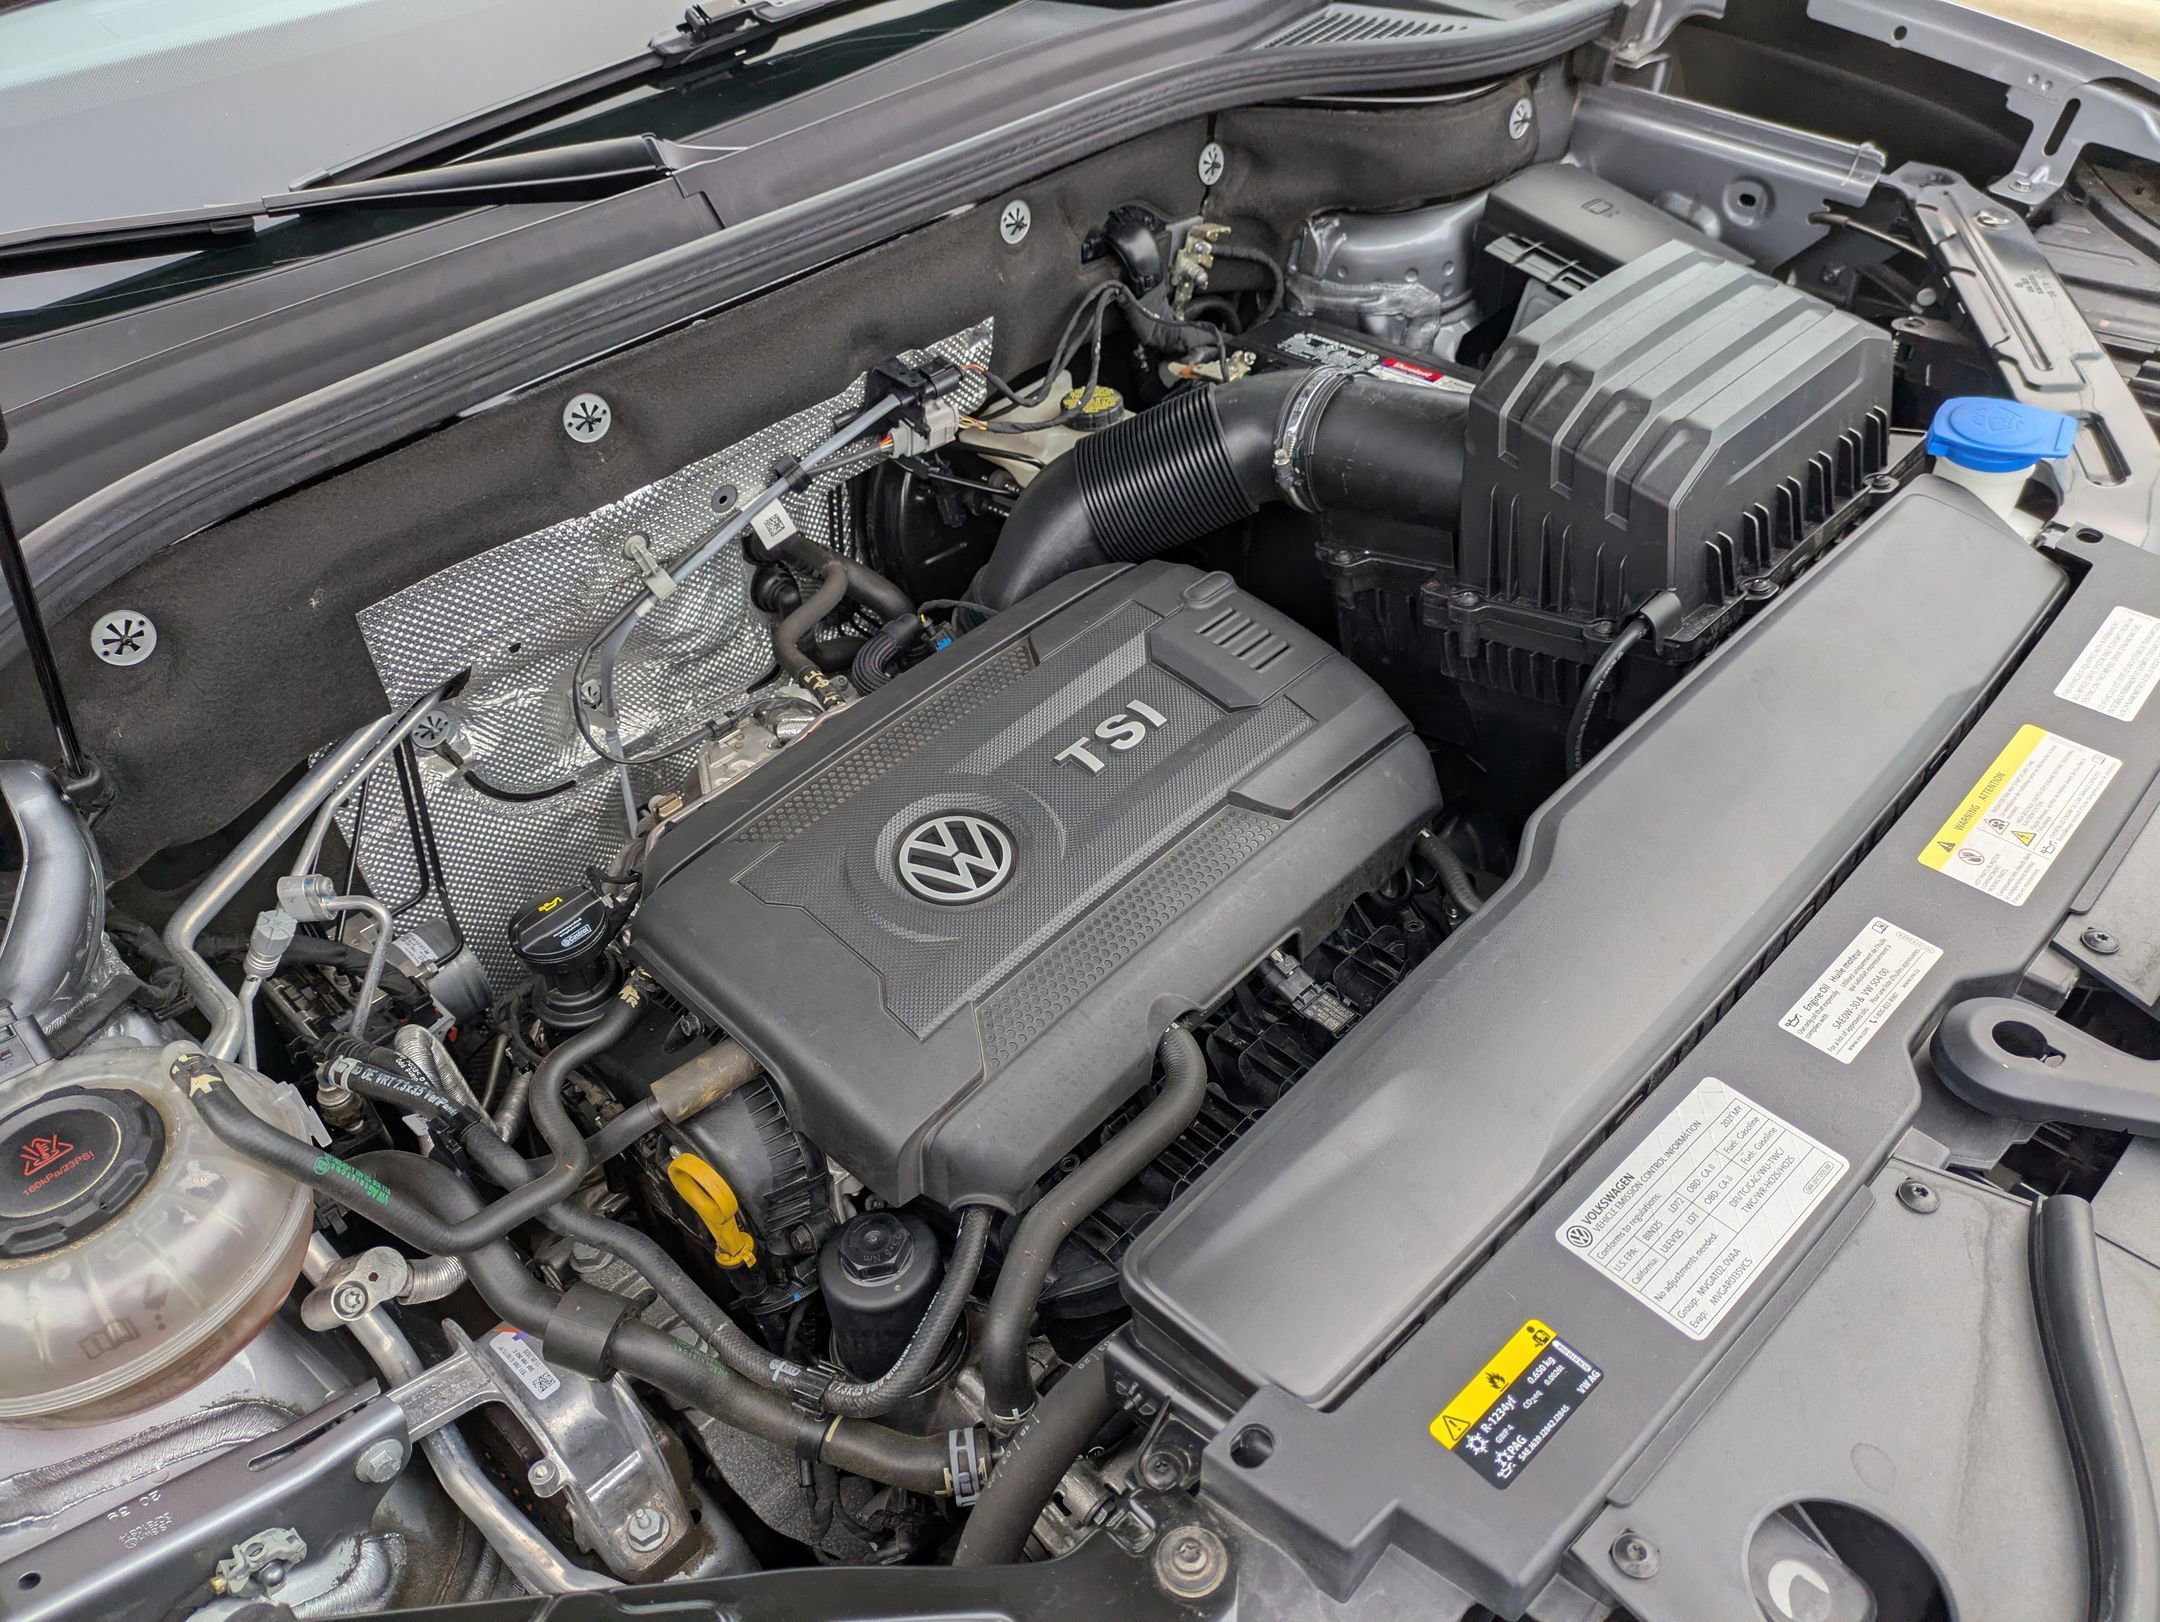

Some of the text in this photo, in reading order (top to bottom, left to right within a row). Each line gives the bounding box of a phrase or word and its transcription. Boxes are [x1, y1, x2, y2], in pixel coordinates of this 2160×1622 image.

[1053, 699, 1167, 776] TSI
[1954, 772, 2004, 830] WARNING ATTENTION
[567, 926, 589, 942] Castrol
[1828, 948, 1861, 982] Huile moteur
[1860, 967, 1889, 996] VW 504 00
[1803, 983, 1830, 1011] Engine Oil
[360, 1065, 377, 1082] OE
[1719, 1105, 1743, 1128] 2021 MY
[1722, 1116, 1759, 1153] Fuel: Gasoline
[1740, 1127, 1777, 1164] Fuel: Gasoline
[1592, 1121, 1701, 1231] VEHICLE EMISSION CONTROL INFORMATION
[1685, 1176, 1703, 1193] OBD:
[1699, 1167, 1712, 1178] CA
[1581, 1173, 1634, 1224] VOLKSWAGEN
[1702, 1188, 1721, 1205] OBD:
[1716, 1178, 1729, 1190] CA
[1596, 1191, 1663, 1259] Conforms to regulations:
[1642, 1196, 1684, 1239] BIN125 LDT2
[1660, 1211, 1699, 1252] ULEV125 LDT
[1612, 1245, 1639, 1272] U.S. EPA:
[1631, 1257, 1658, 1284] California:
[1653, 1231, 1718, 1302] No adjustments needed.
[1677, 1296, 1700, 1319] Group:
[1689, 1309, 1709, 1329] Evap:
[1526, 1354, 1557, 1384] 0.650 kg
[1575, 1368, 1600, 1394] VW AG
[1480, 1394, 1518, 1435] R-1234yf
[1493, 1427, 1511, 1445] GWP
[1506, 1434, 1527, 1455] PAG
[1516, 1446, 1532, 1462] SAE
